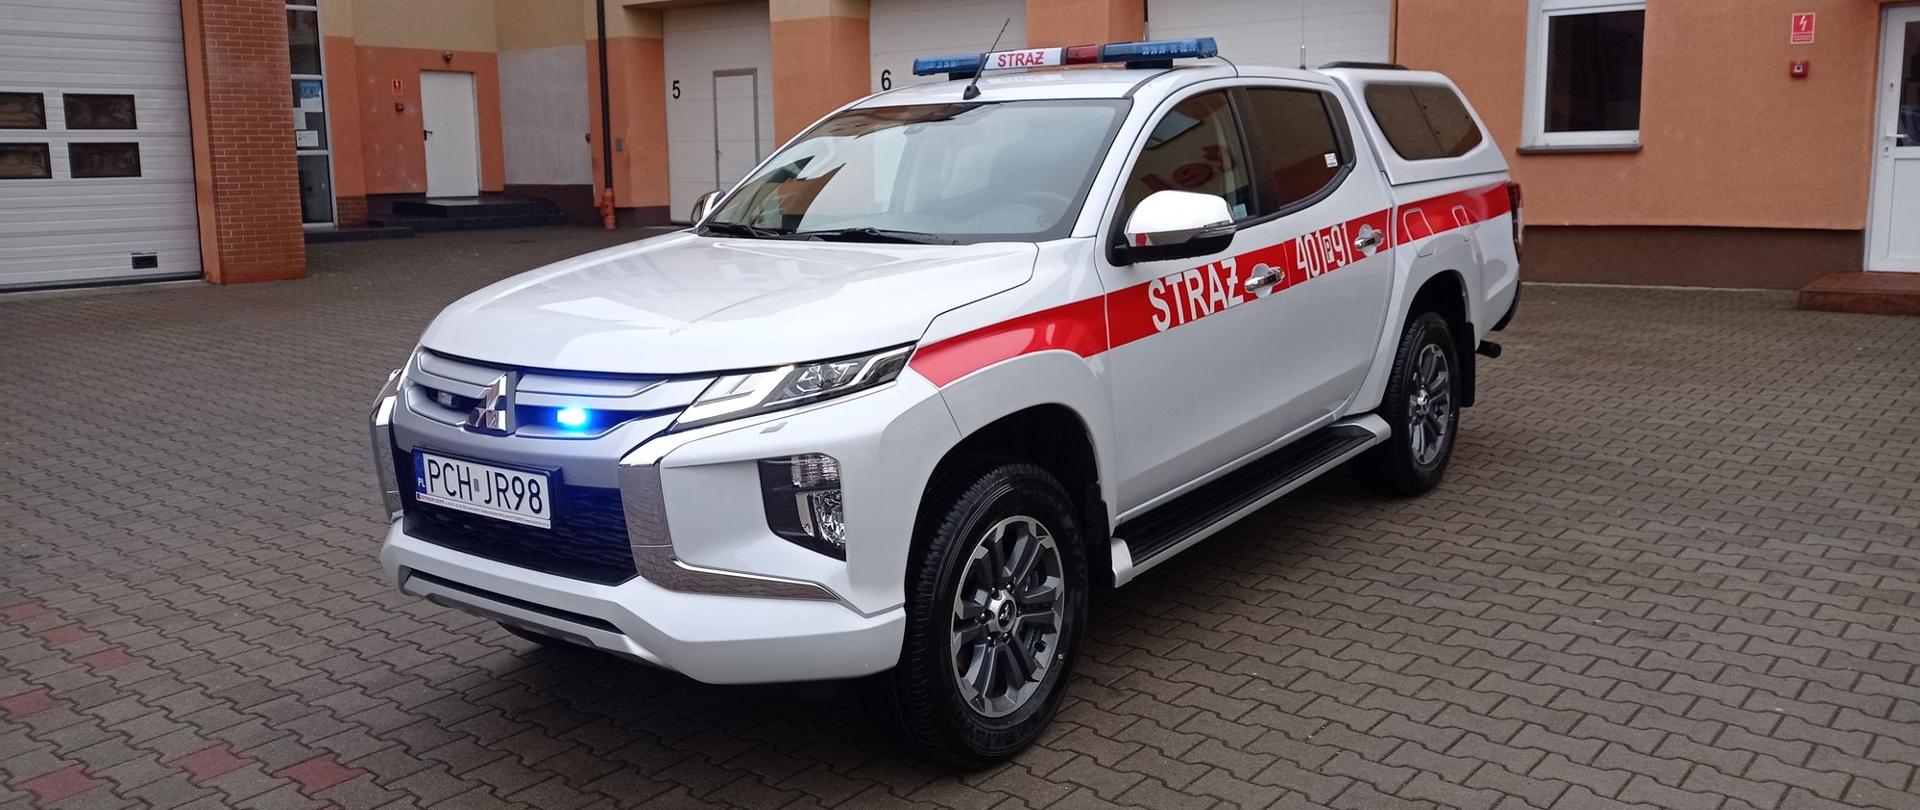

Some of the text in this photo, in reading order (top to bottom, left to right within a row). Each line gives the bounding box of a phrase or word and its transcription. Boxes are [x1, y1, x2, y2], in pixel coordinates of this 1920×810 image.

[672, 80, 681, 99] 5
[881, 69, 892, 91] 6
[417, 477, 426, 488] PL
[428, 458, 473, 501] PCH
[484, 470, 543, 514] JR98
